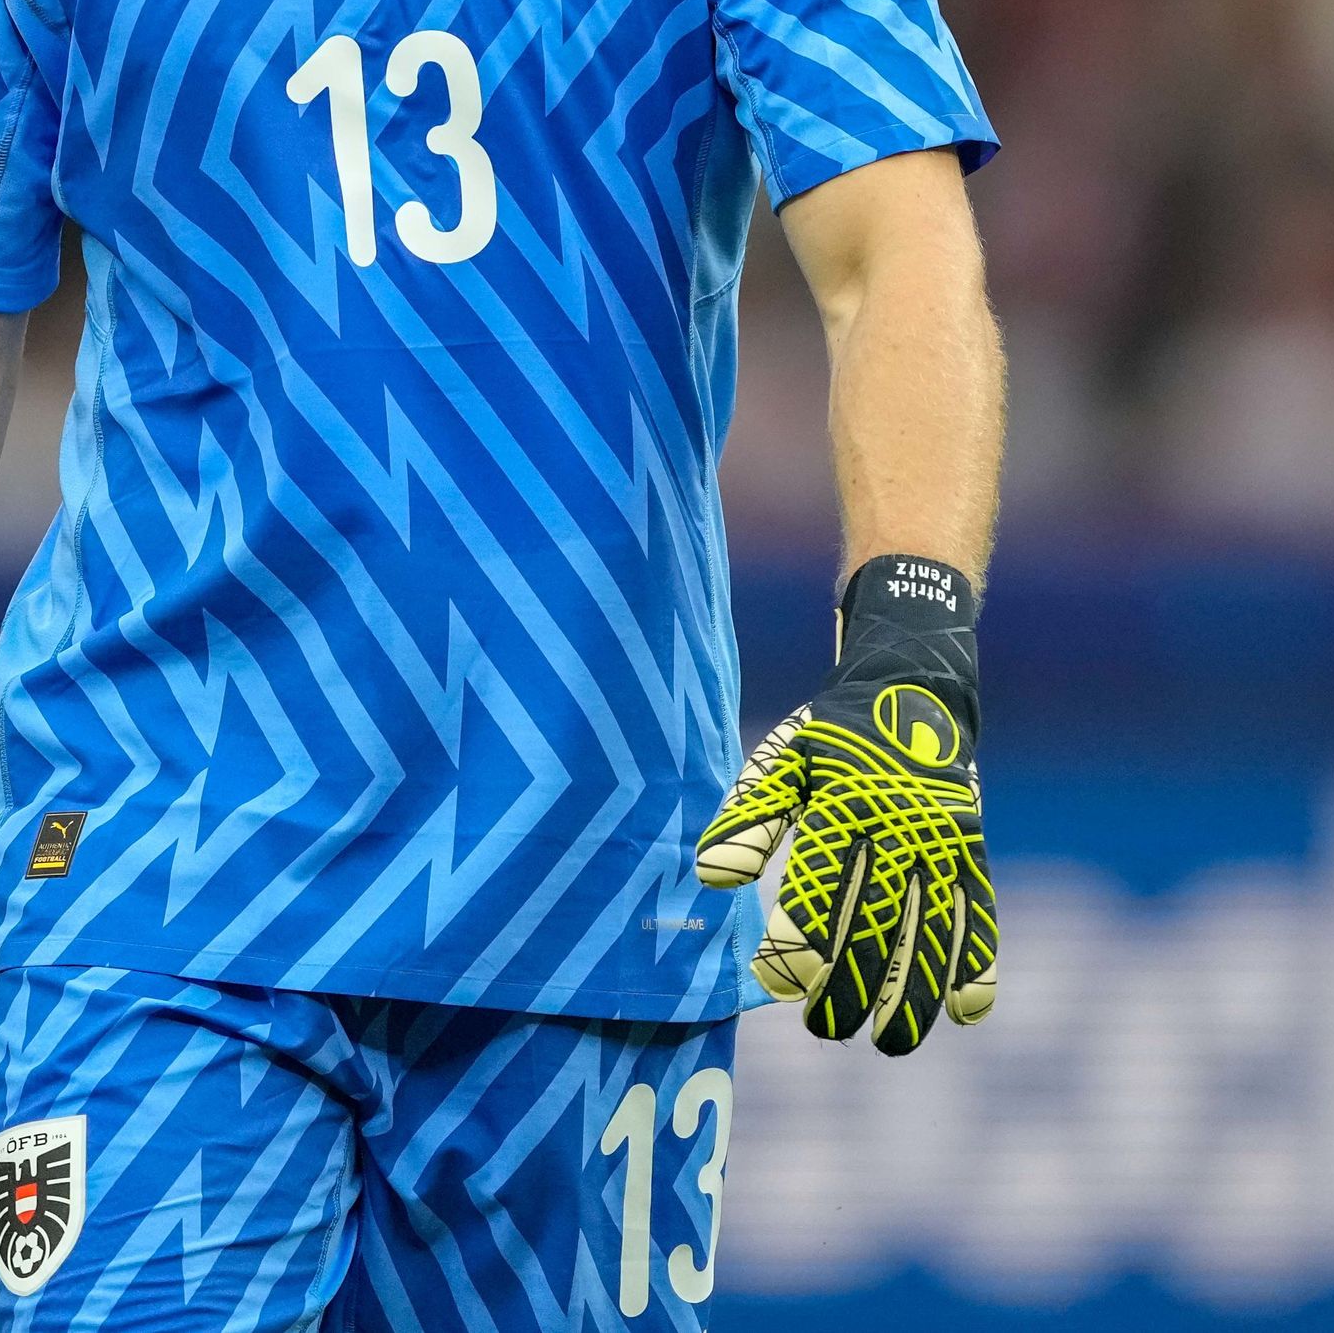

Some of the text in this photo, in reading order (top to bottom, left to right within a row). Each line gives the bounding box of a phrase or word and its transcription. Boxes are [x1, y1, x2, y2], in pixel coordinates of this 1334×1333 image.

[286, 30, 497, 267] 13
[896, 562, 952, 591] Pentz
[887, 580, 957, 612] Patrick
[34, 855, 66, 863] FOOTBALL
[7, 1133, 48, 1154] ÖFB
[600, 1067, 734, 1318] 13
